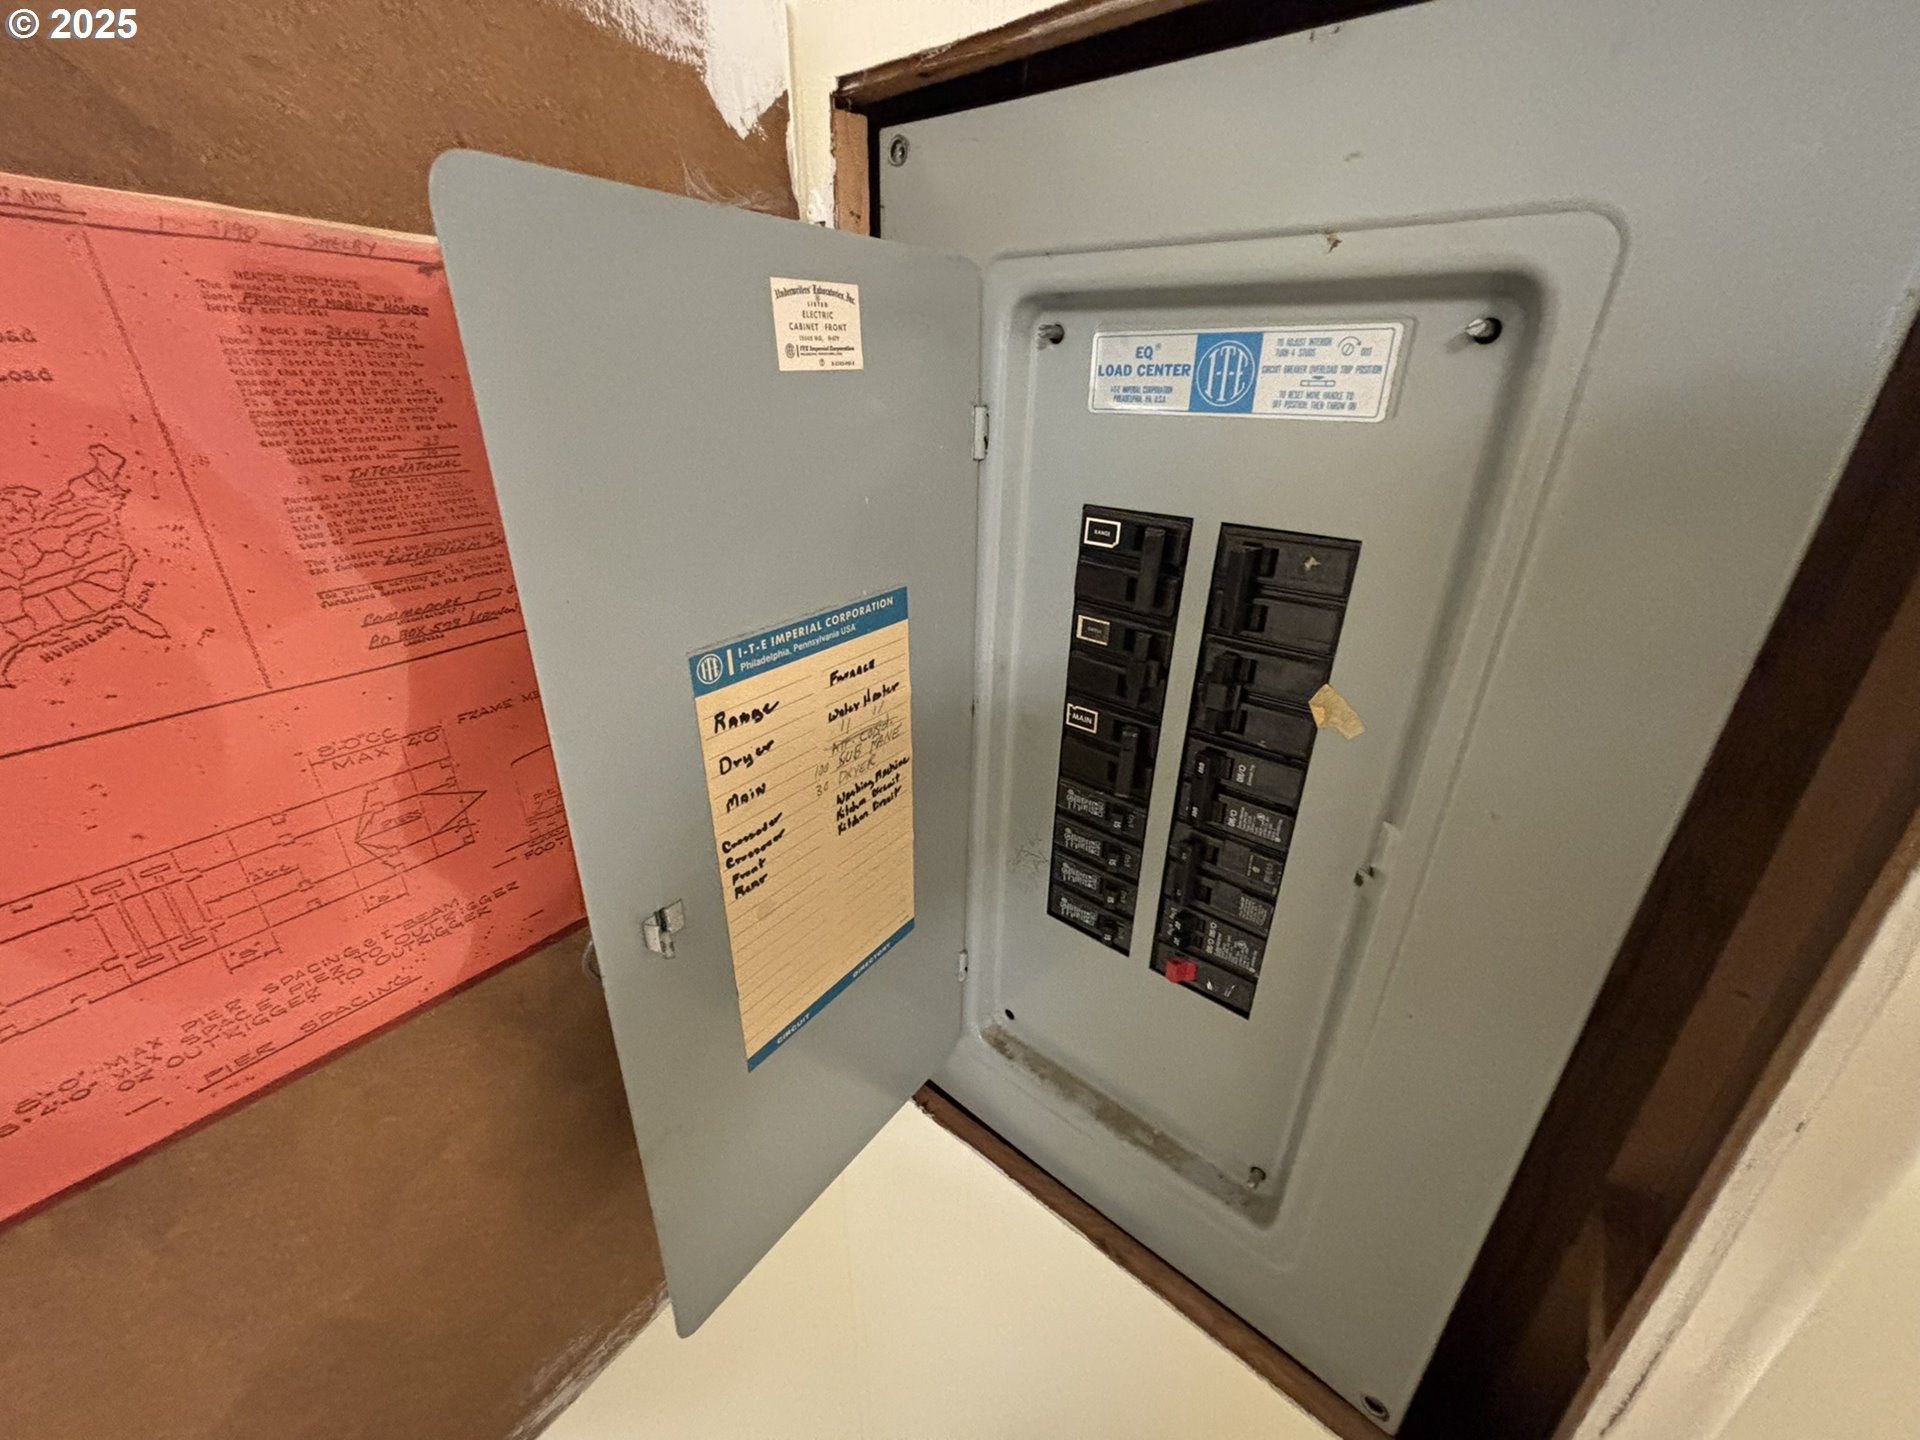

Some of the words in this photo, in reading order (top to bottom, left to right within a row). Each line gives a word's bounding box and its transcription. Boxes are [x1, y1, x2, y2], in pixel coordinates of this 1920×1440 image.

[324, 299, 376, 312] MOBILE
[802, 310, 834, 320] ELECTRIC
[788, 321, 819, 331] CABINET
[824, 322, 848, 332] FRONT
[1098, 363, 1133, 377] LOAD
[1136, 363, 1192, 377] CENTER
[1262, 364, 1281, 375] CIRCUIT
[1283, 364, 1308, 375] BREAKER
[1309, 364, 1338, 375] OVERLOAD
[1355, 364, 1384, 375] POSITION
[1288, 390, 1305, 400] RESET
[1306, 390, 1322, 400] MOVE
[1323, 390, 1344, 401] HANDLE
[1309, 401, 1325, 410] THEN
[348, 458, 464, 481] INTERNATIONAL
[1093, 528, 1111, 538] RANGE
[737, 638, 768, 659] I-T-E
[771, 620, 822, 647] IMPERIAL
[825, 596, 894, 628] CORPORATION
[740, 648, 793, 672] Philadelphia,
[793, 630, 840, 653] Pennsylvania
[841, 622, 857, 636] USA
[714, 701, 779, 734] Range
[1071, 712, 1093, 725] MAIN
[332, 746, 390, 771] MAX
[718, 739, 775, 776] Dryer
[836, 780, 875, 805] Washing
[875, 756, 910, 783] Machine
[732, 857, 767, 886] Front
[735, 872, 769, 900] Rear
[165, 986, 323, 1070] OUTRIGGER
[331, 967, 364, 985] TO
[374, 906, 496, 966] OUTRIGGER
[179, 997, 272, 1047] SPACE
[354, 945, 386, 965] TO
[180, 997, 244, 1033] PIER
[262, 946, 360, 995] SPACING
[776, 1013, 811, 1045] CIRCUIT
[852, 942, 892, 978] DIRECTORY
[203, 1041, 277, 1083] PIER
[299, 974, 414, 1034] SPACING
